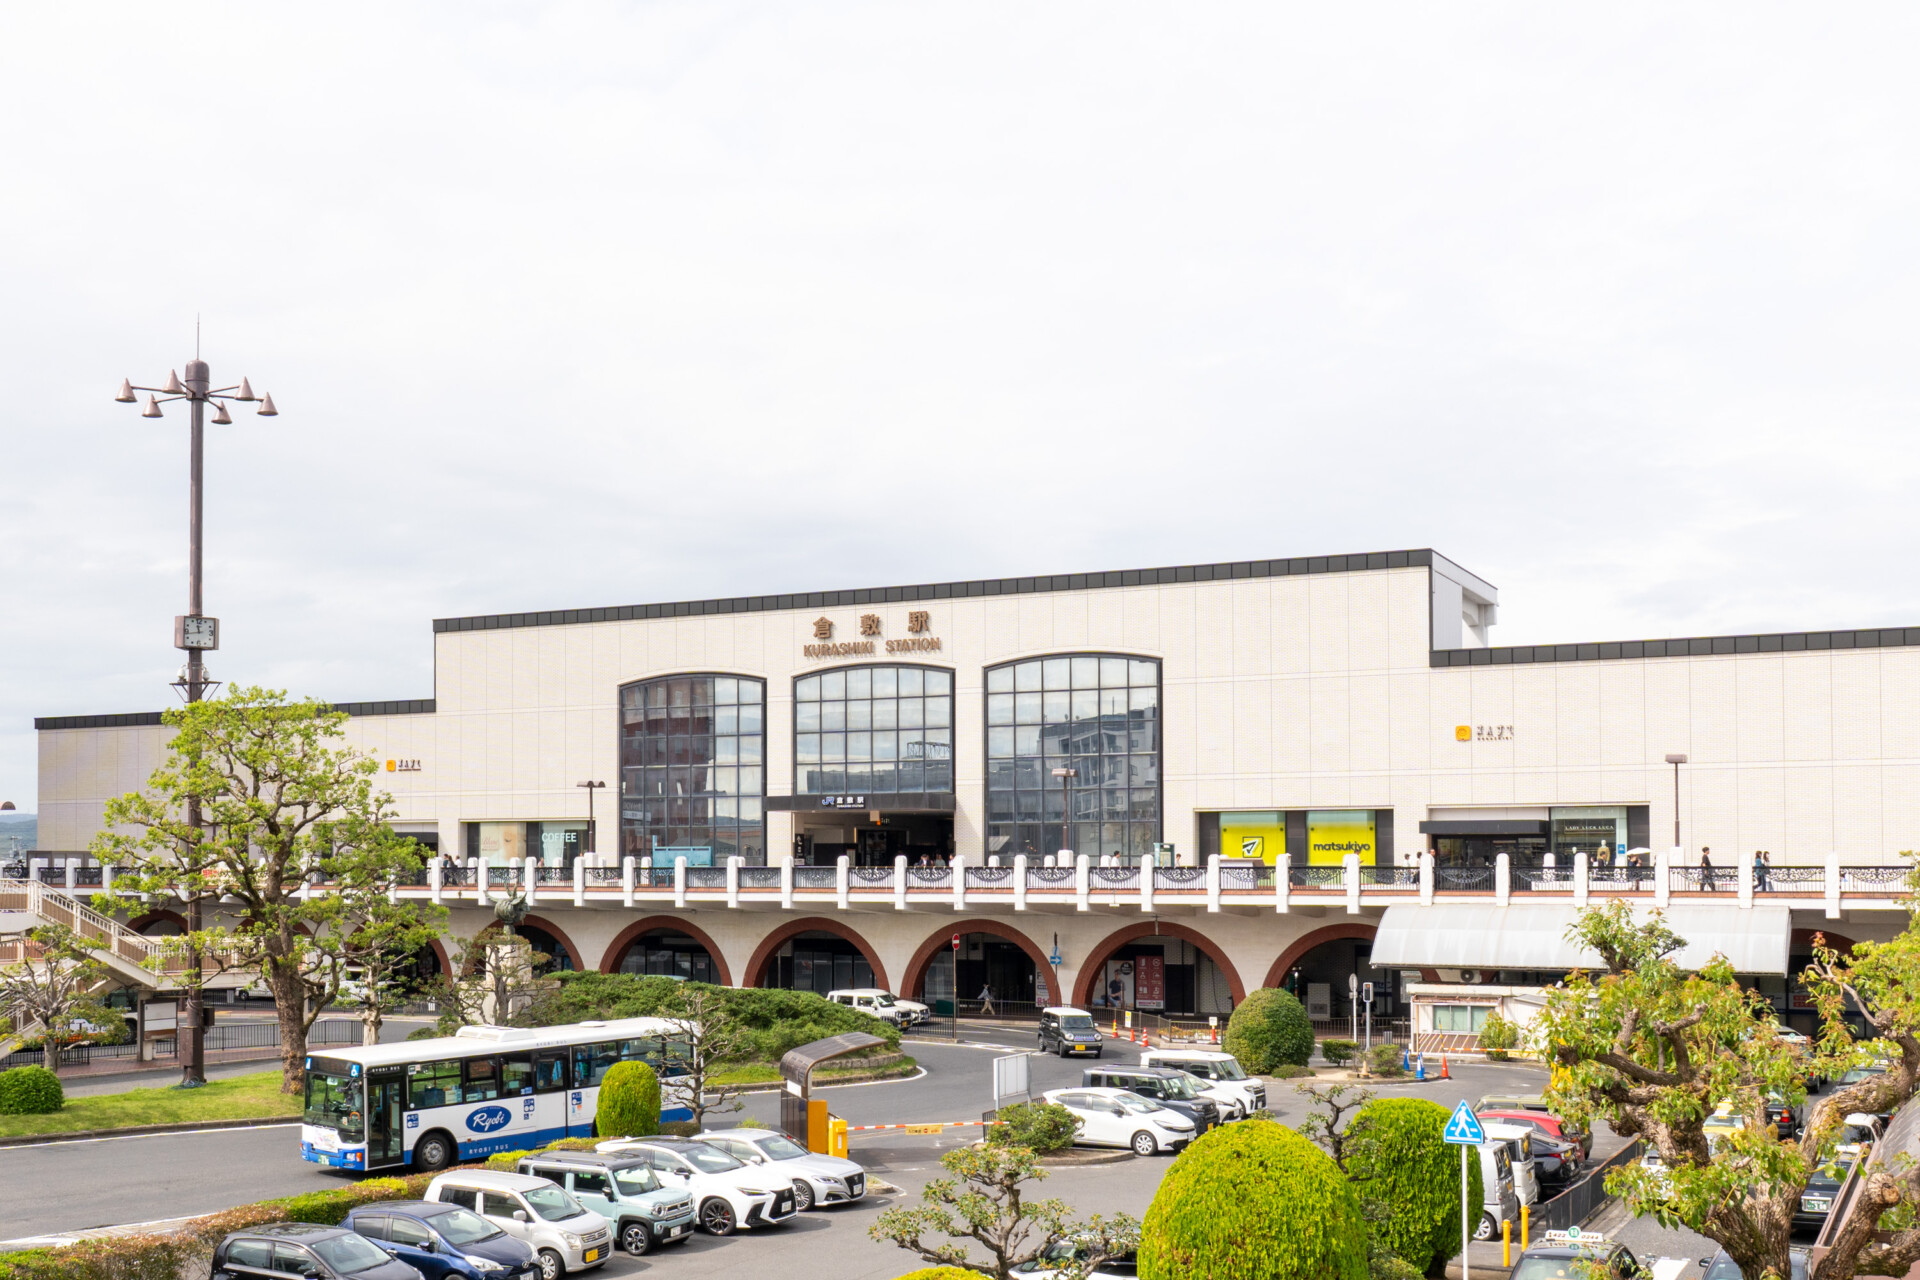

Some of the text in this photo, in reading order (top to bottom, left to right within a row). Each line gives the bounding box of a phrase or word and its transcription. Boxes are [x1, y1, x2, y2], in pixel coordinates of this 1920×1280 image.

[813, 611, 929, 639] 倉敷駅
[803, 637, 941, 657] KURASHIKI STATION
[822, 796, 835, 806] JR
[541, 832, 577, 843] COFFEE
[1313, 841, 1371, 853] matsukiyo
[472, 1110, 505, 1132] Ryobi
[468, 1143, 509, 1155] RYOBI BUS
